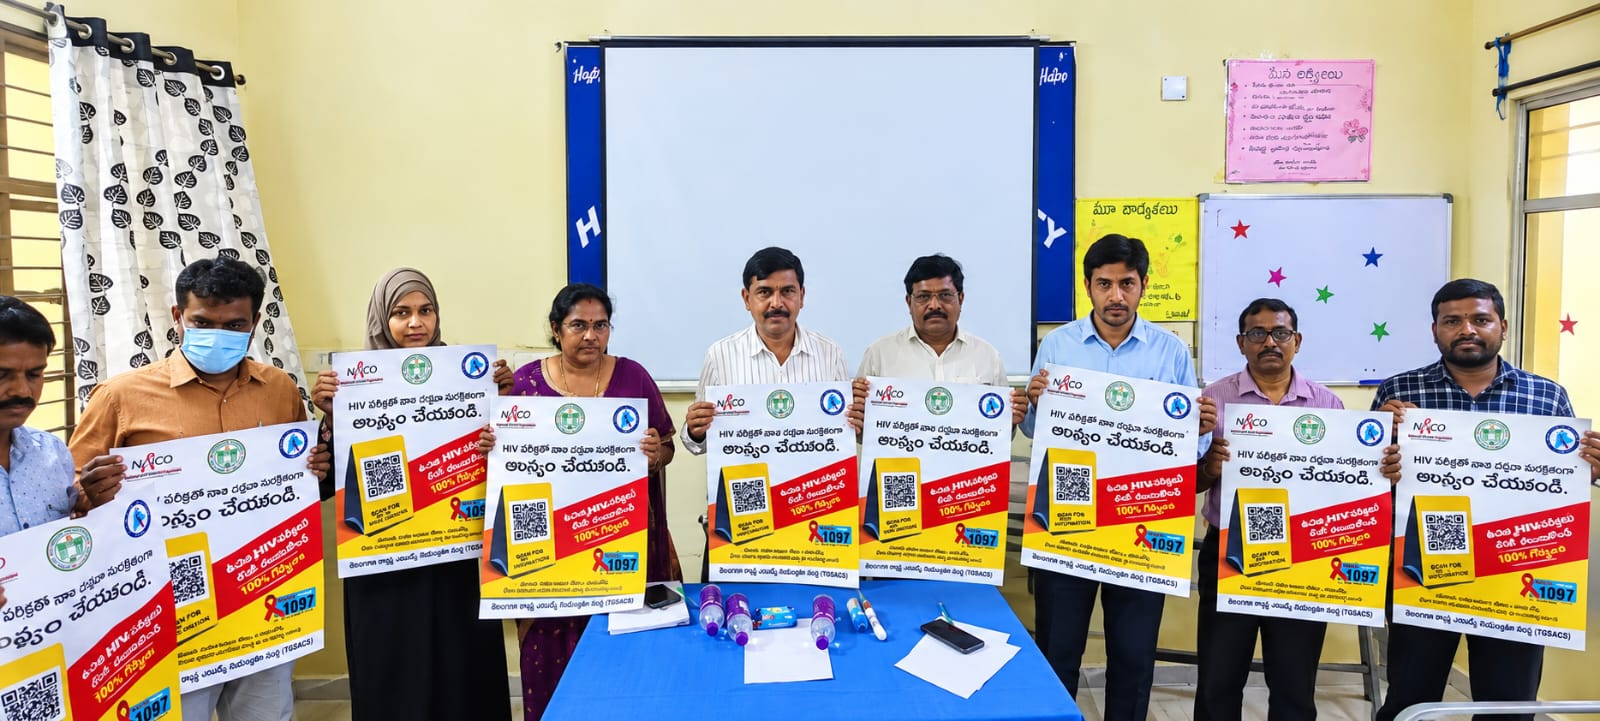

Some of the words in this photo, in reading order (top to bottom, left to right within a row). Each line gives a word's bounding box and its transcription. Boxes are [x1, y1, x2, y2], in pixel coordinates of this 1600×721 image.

[349, 401, 366, 411] HIV
[1050, 409, 1066, 419] HIV
[876, 420, 890, 429] HIV
[719, 429, 733, 438] HIV
[503, 444, 519, 454] HIV
[1238, 450, 1254, 460] HIV
[1414, 455, 1432, 465] HIV
[466, 504, 485, 518] 109
[822, 531, 849, 544] 1097
[969, 533, 997, 547] 1097
[1152, 536, 1182, 553] 1097
[608, 558, 637, 571] 1097
[1346, 568, 1377, 584] 1097
[1539, 585, 1574, 601] 1097
[282, 594, 314, 616] 1097
[135, 696, 169, 721] 1097
